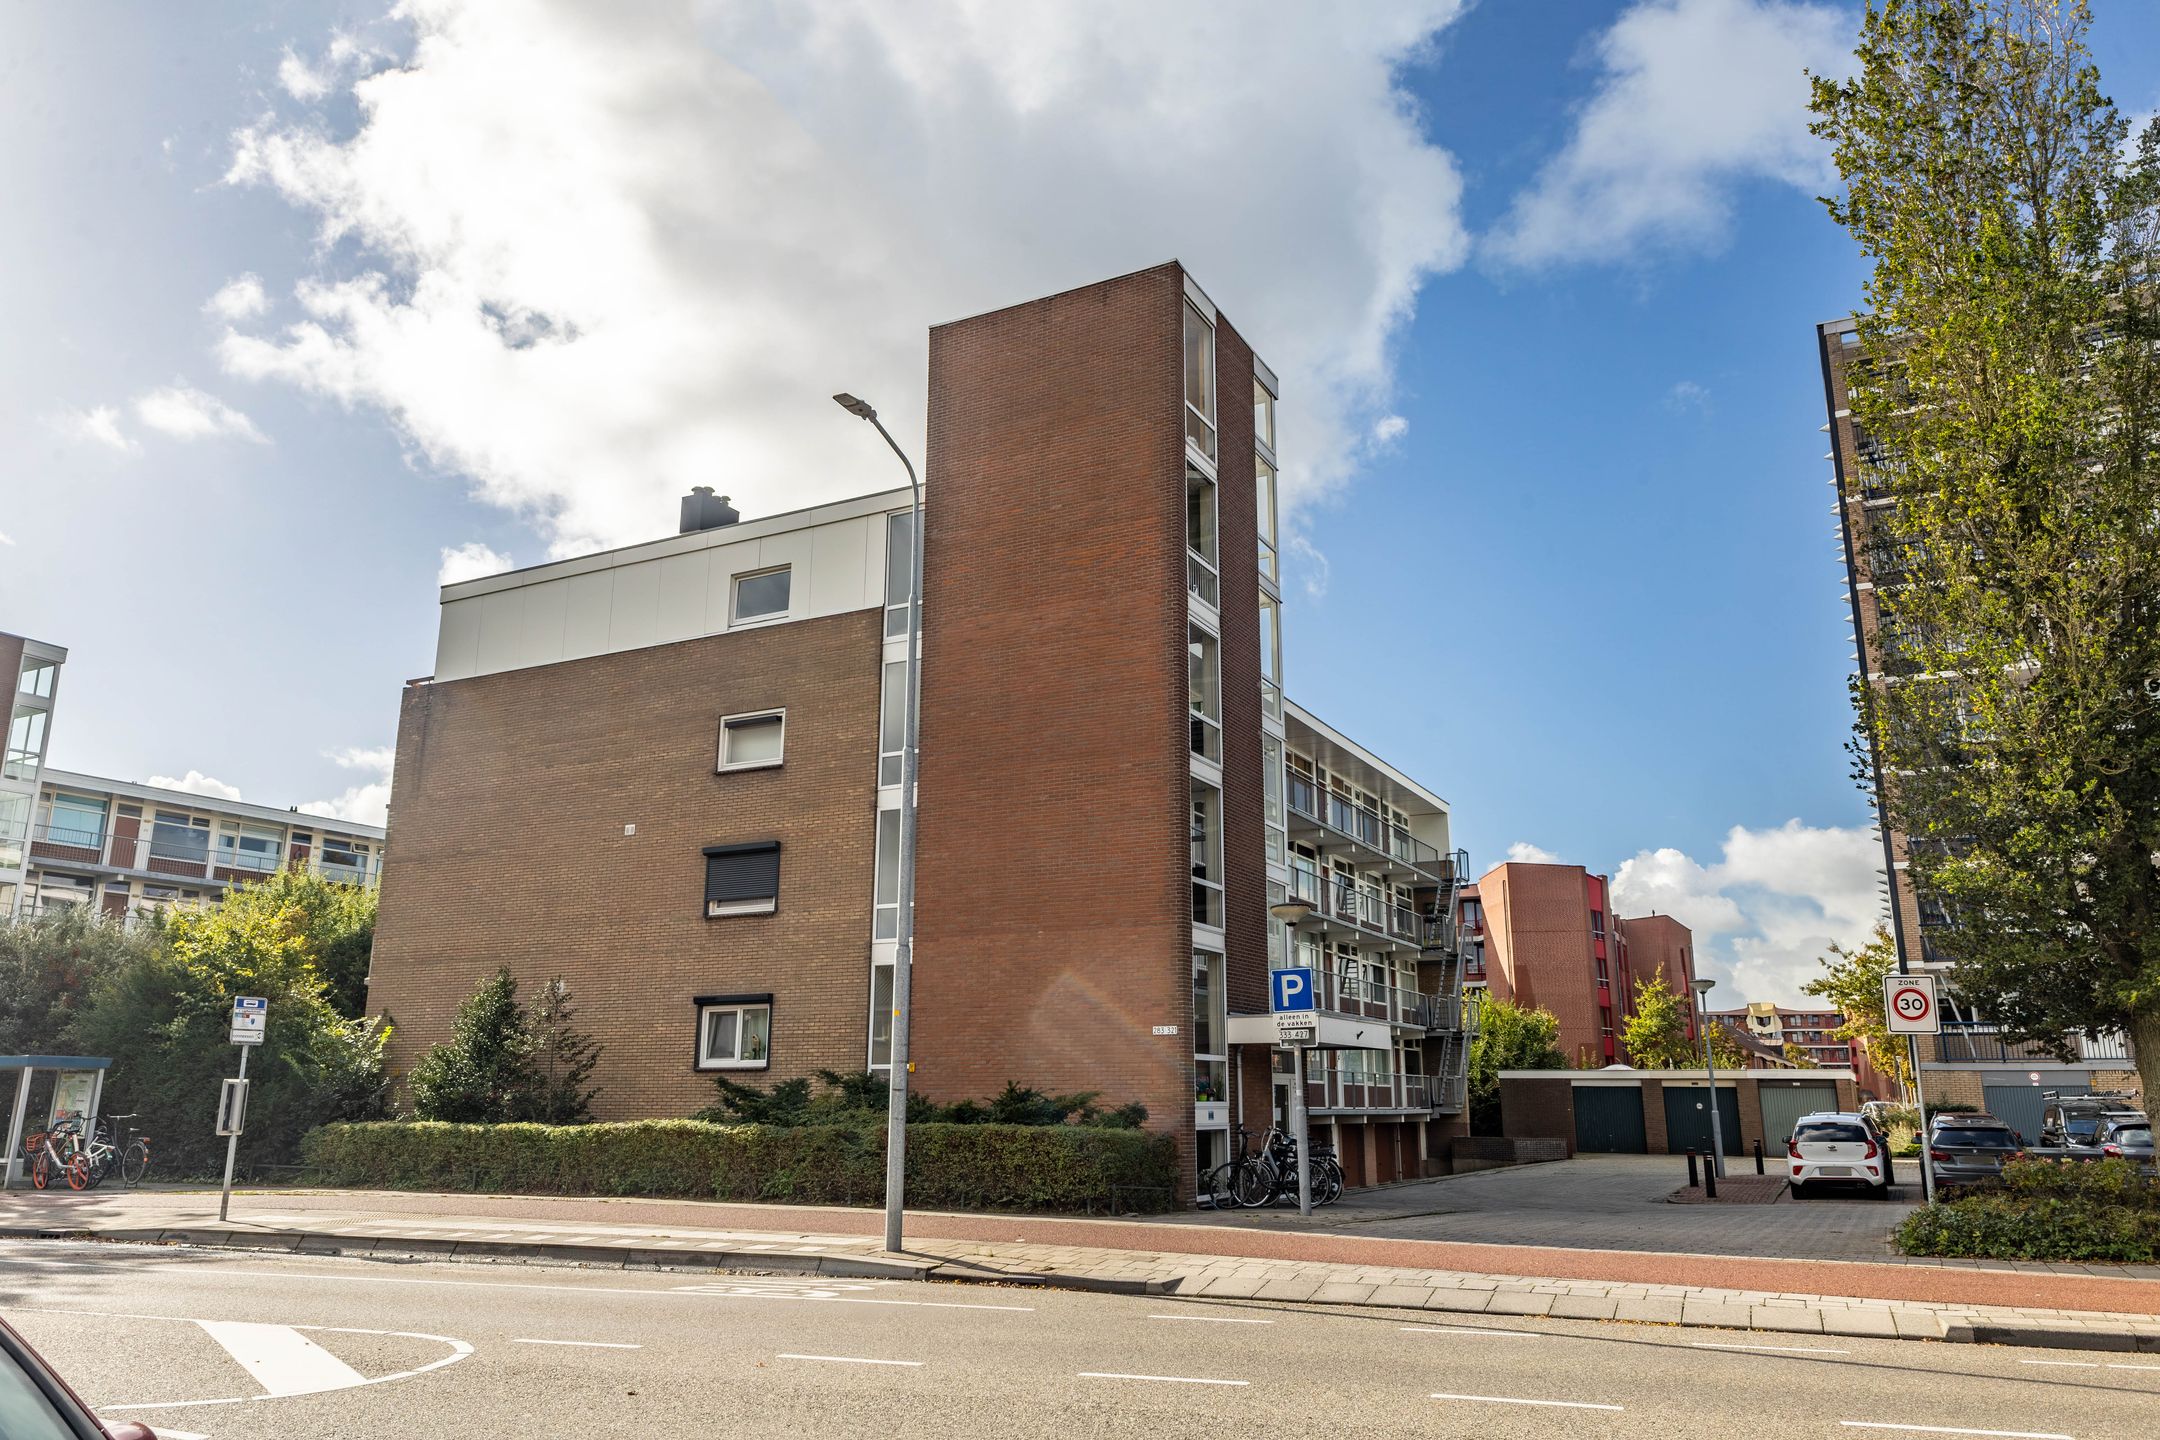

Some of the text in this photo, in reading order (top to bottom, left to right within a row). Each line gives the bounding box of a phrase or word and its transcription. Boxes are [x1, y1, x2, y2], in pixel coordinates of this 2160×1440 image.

[1280, 974, 1304, 1007] P
[1900, 998, 1923, 1011] 30
[1279, 1030, 1308, 1039] 333 427
